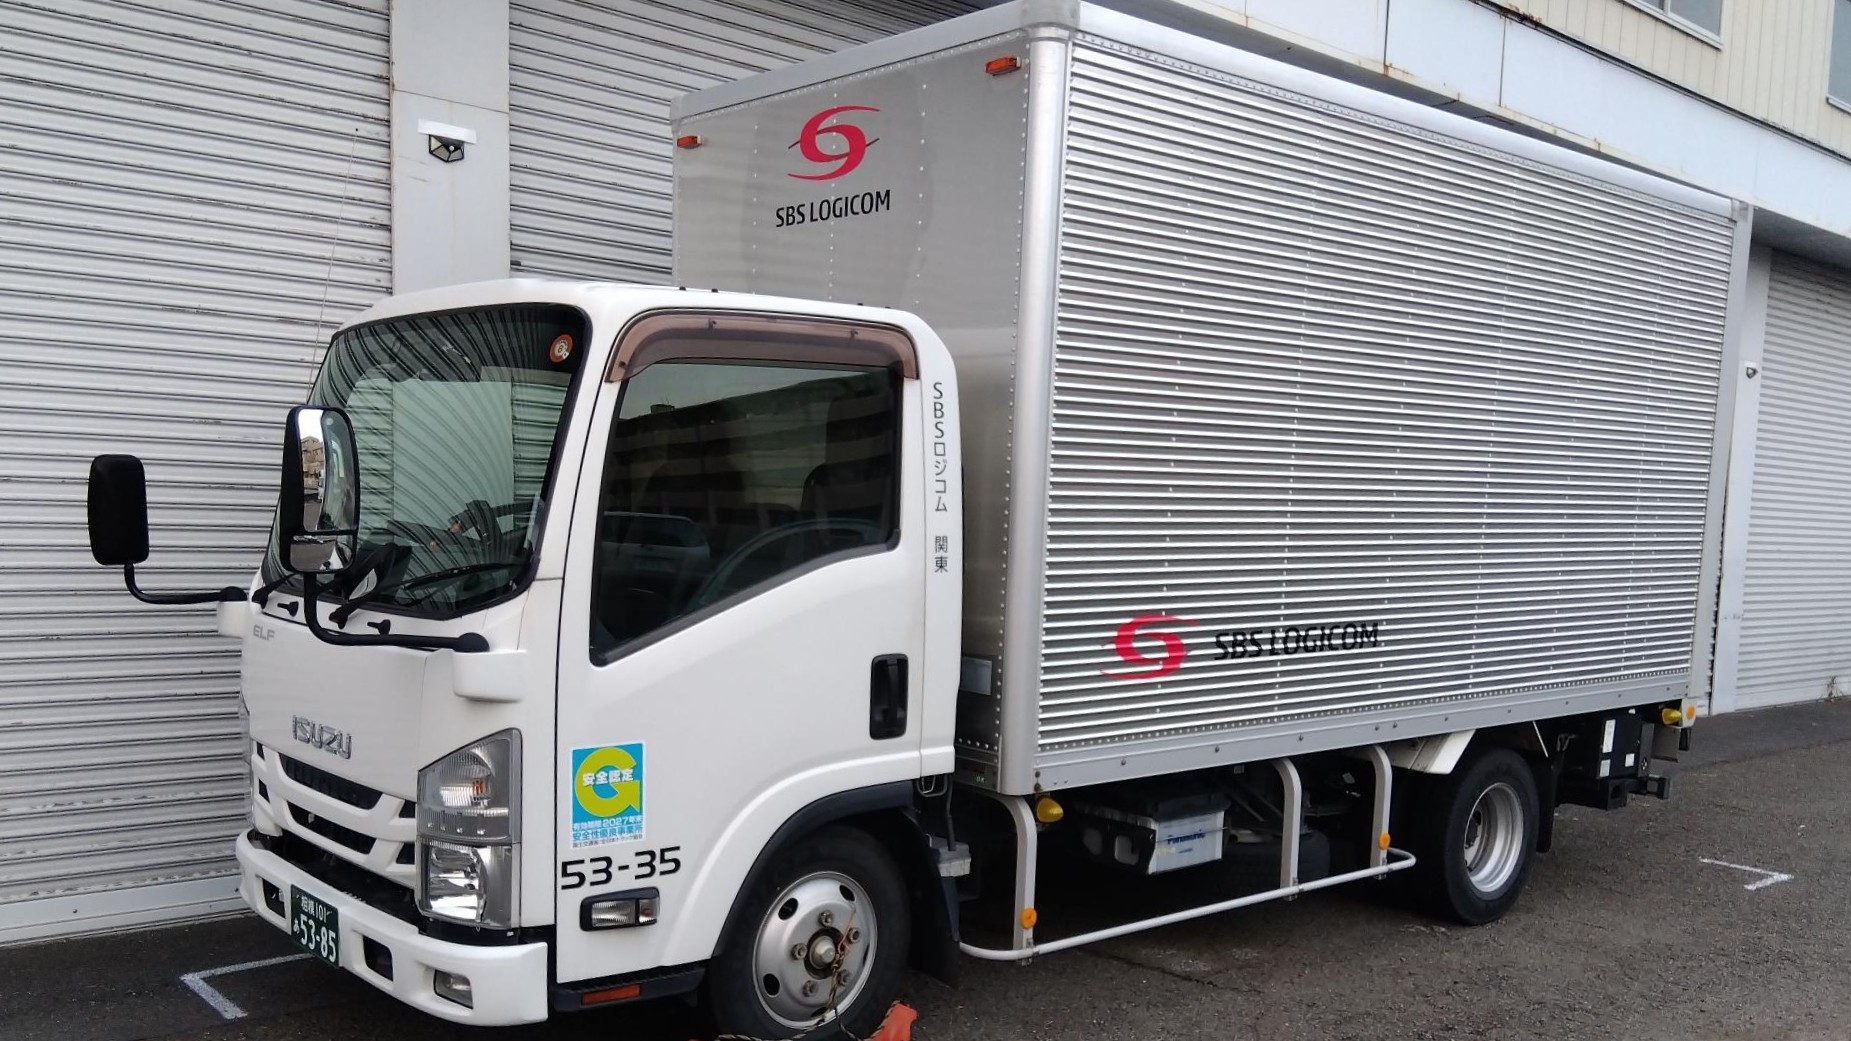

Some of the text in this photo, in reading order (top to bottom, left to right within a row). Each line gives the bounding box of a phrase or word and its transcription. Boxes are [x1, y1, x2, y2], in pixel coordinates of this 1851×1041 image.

[776, 190, 890, 227] SBS LOGICOM
[933, 382, 949, 573] SBSロジコム 関東
[253, 624, 275, 641] ELF
[1214, 623, 1379, 660] SBS LOGICOM
[292, 715, 352, 760] ISUZU
[583, 768, 634, 787] 安全認定
[561, 846, 681, 890] 53-35
[300, 913, 336, 963] 53-85
